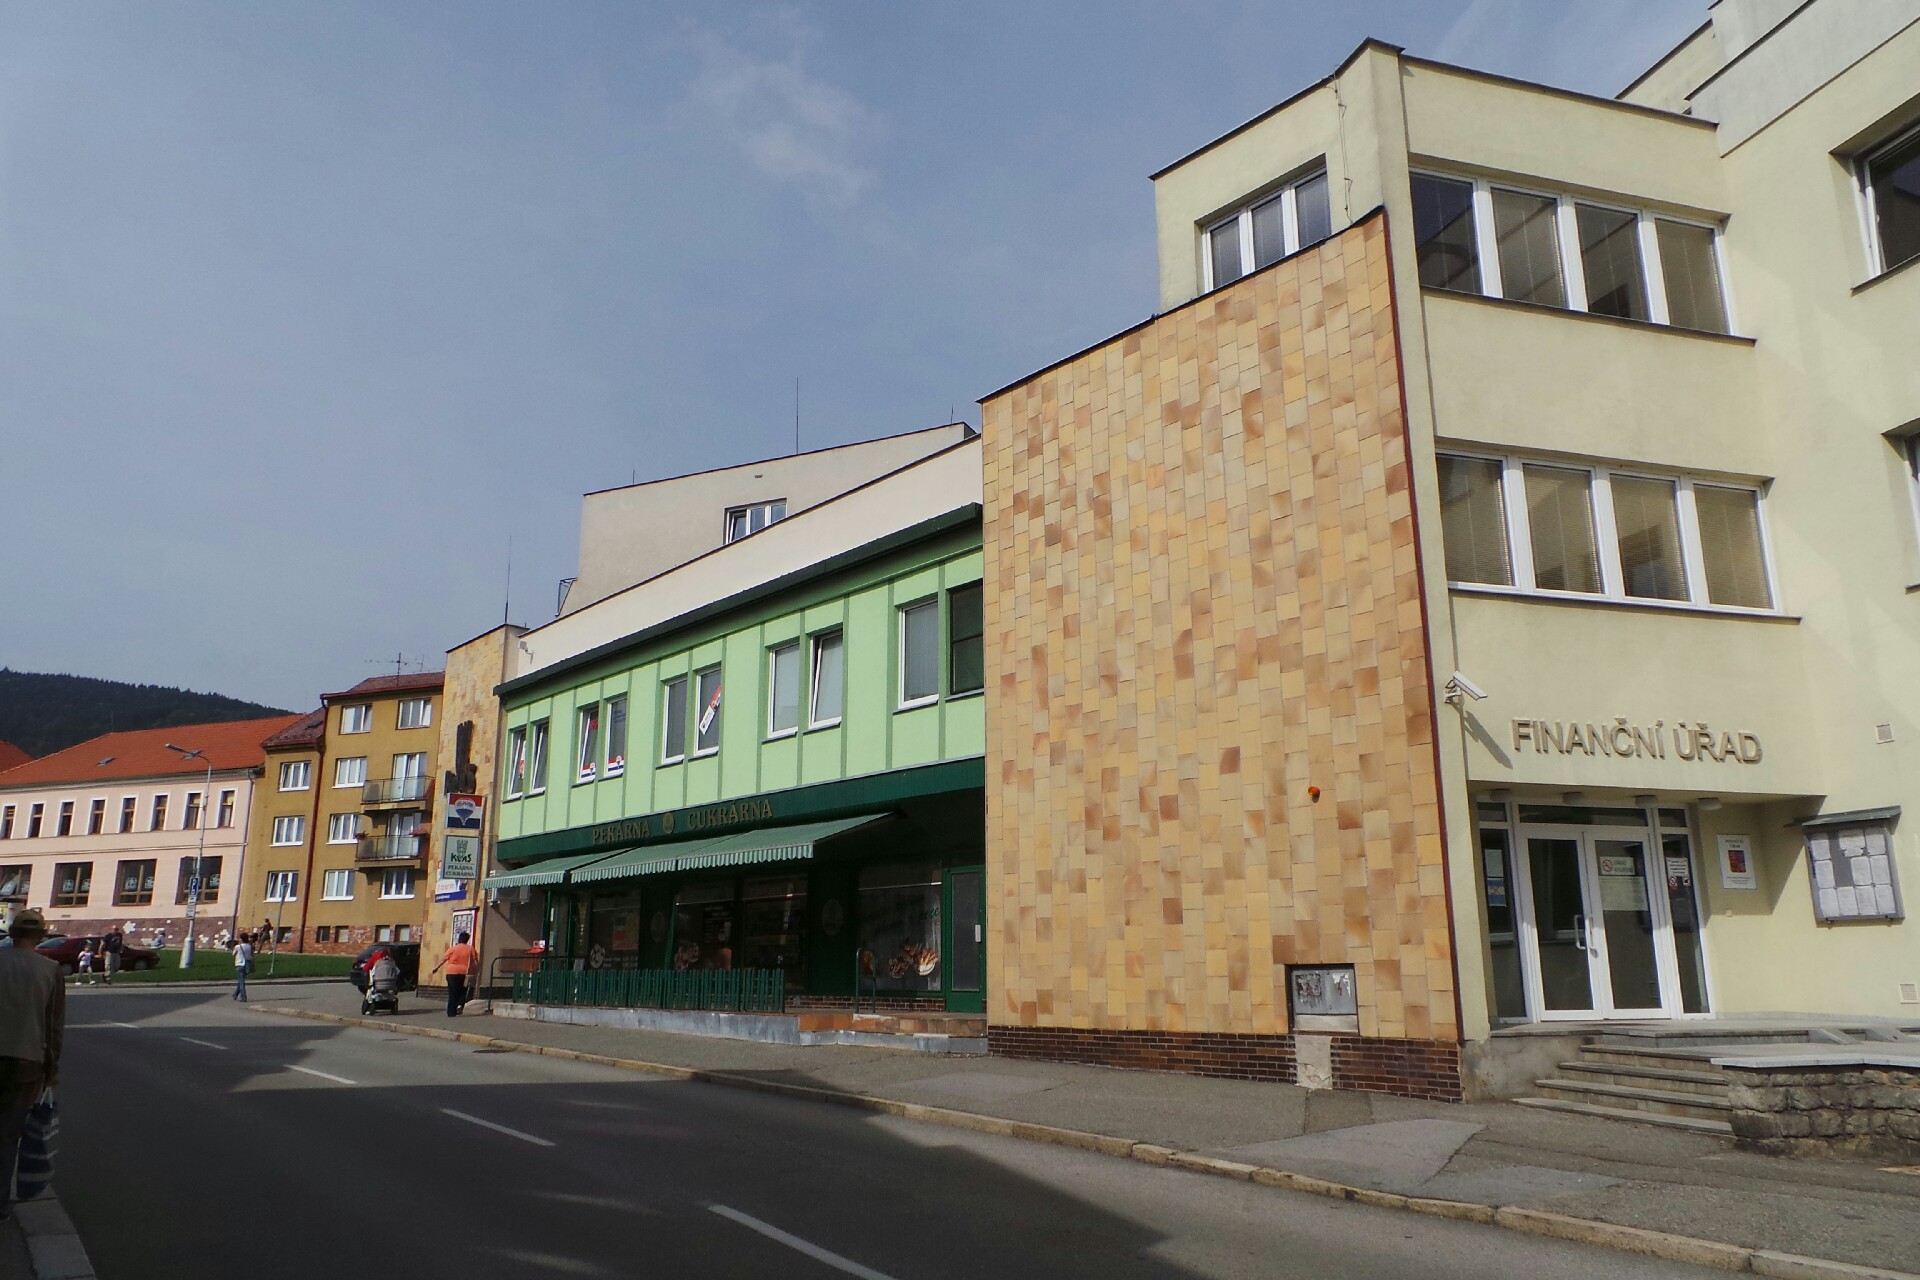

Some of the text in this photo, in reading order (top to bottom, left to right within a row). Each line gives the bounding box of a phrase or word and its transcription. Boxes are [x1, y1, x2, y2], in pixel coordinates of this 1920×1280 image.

[1511, 715, 1763, 764] FINANČNÍ ÚŘAD
[592, 799, 773, 846] PEKÁRNA CUKRÁRNA
